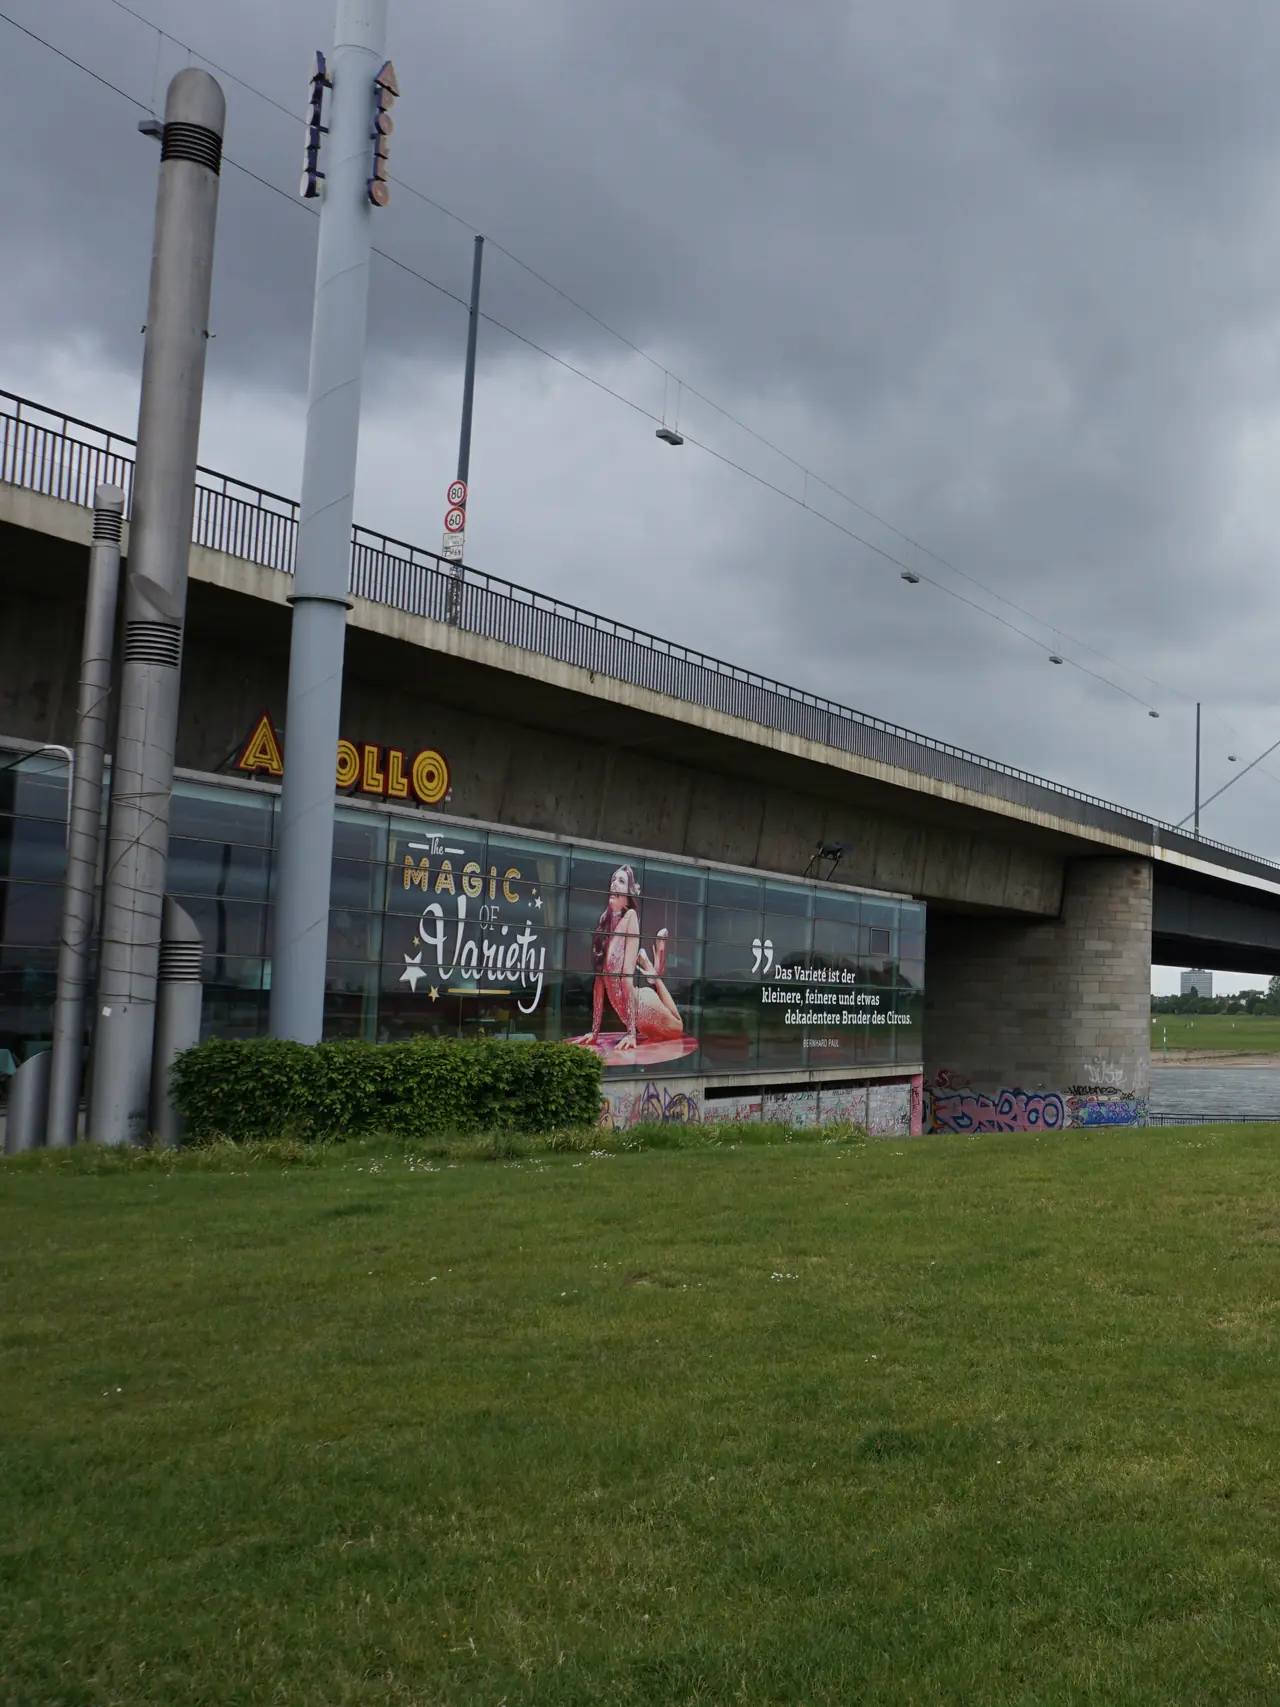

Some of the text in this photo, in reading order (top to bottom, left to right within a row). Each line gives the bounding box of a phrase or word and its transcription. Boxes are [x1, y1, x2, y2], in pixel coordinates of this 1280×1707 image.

[451, 487, 463, 500] 80
[448, 513, 461, 526] 60
[234, 707, 450, 804] AOLLO
[425, 833, 445, 855] The
[403, 855, 521, 903] MAGIC
[479, 905, 500, 931] OF
[419, 894, 546, 1014] Variety
[774, 964, 856, 984] Das Varieté ist der
[761, 987, 880, 1006] kleinere, feinere und etwas
[784, 1009, 912, 1025] dekadentere Bruder des Circus.
[802, 1038, 840, 1048] BERNHARD PAUL
